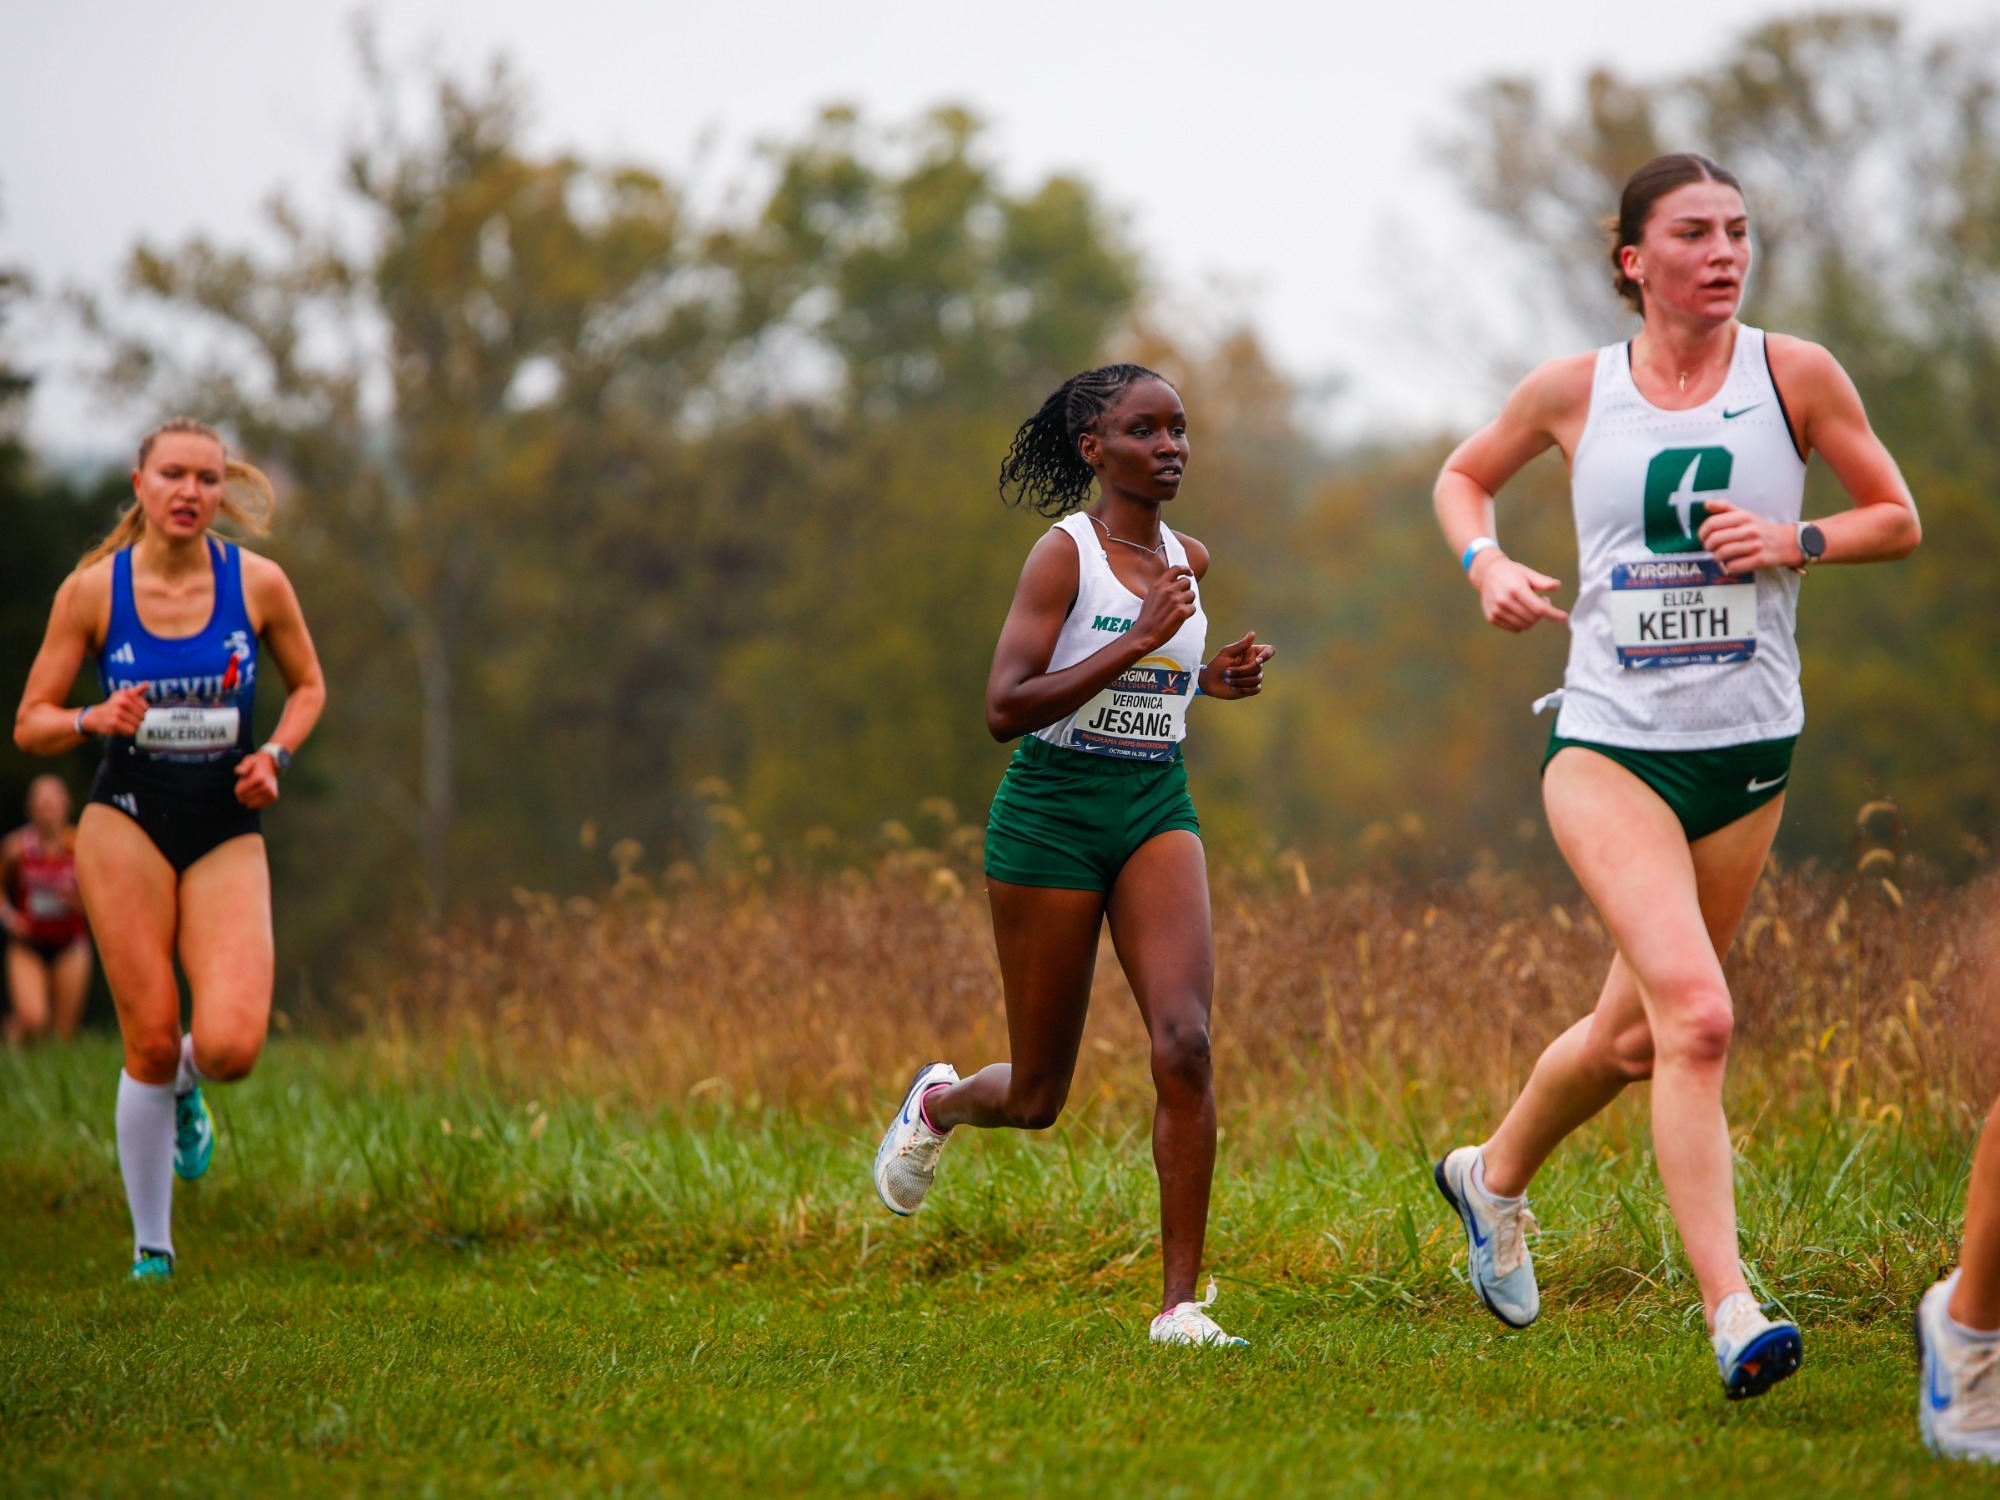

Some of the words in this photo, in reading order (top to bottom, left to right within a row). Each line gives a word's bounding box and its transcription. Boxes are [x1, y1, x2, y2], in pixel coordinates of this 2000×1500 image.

[1626, 562, 1702, 578] VIRGINIA
[1663, 591, 1704, 607] ELIZA
[1091, 615, 1137, 633] MEA
[1639, 606, 1729, 641] KEITH
[1127, 682, 1158, 690] COUNTRY
[1113, 693, 1163, 710] VERONICA
[1088, 707, 1172, 738] JESANG
[147, 726, 228, 741] KUCEROVA
[1081, 733, 1117, 745] PANORAMA
